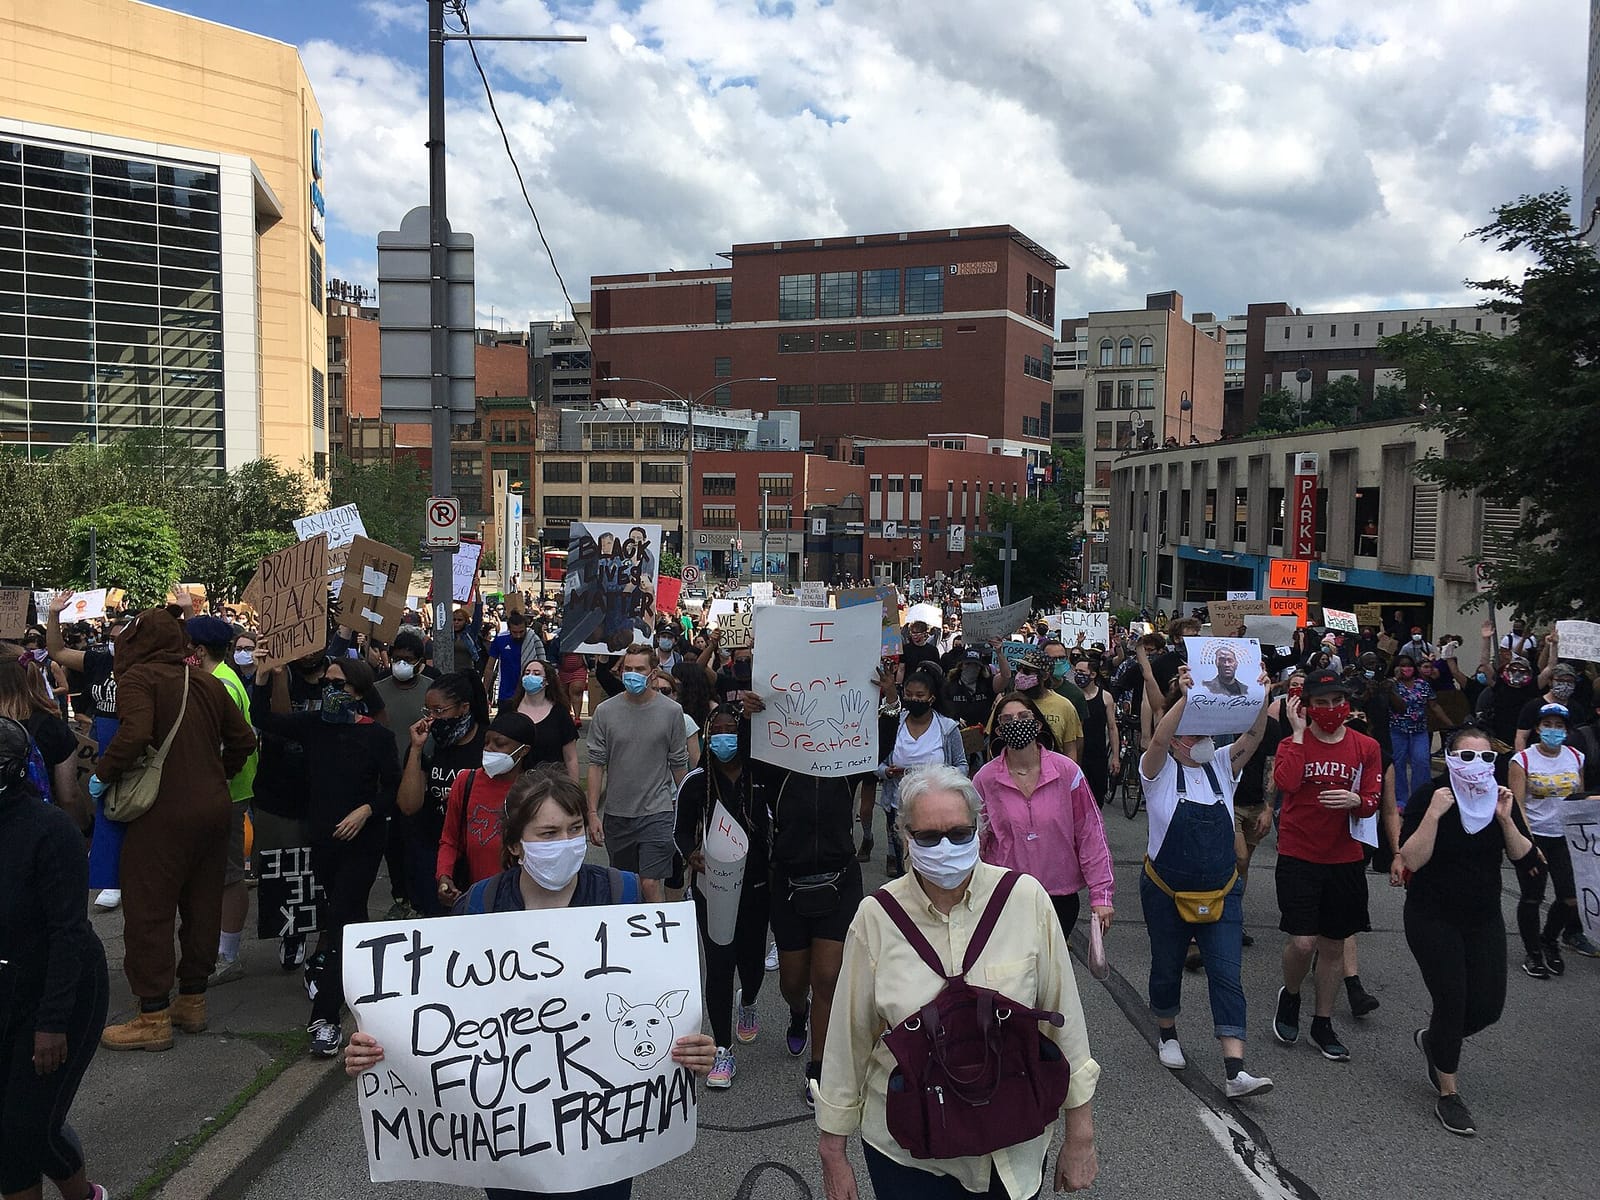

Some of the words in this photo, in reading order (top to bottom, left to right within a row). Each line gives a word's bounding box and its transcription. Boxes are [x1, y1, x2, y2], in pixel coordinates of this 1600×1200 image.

[1300, 480, 1313, 538] PARK
[579, 535, 651, 562] BLACK
[262, 536, 325, 593] PROTECT
[583, 563, 642, 585] LIVES
[1282, 563, 1297, 572] 7TH
[1281, 577, 1296, 586] AVE
[261, 580, 325, 636] BLACK
[570, 589, 654, 617] MATTER
[1274, 601, 1303, 610] DETOUR
[717, 614, 735, 627] WE
[1062, 613, 1101, 627] BLACK
[719, 628, 752, 646] BREA
[809, 622, 834, 643] I
[771, 673, 848, 694] Can't
[768, 720, 870, 753] Breathe!
[431, 767, 457, 781] BLA
[811, 761, 832, 771] Am
[834, 761, 843, 770] I
[848, 756, 872, 768] next?
[1304, 761, 1360, 781] EMPLE
[279, 905, 317, 937] CK
[354, 929, 434, 1005] It
[446, 941, 565, 988] was
[584, 910, 681, 980] 1st
[412, 997, 592, 1065] Degree.
[431, 1032, 618, 1110] FUCK
[362, 1069, 418, 1098] D.A.
[371, 1102, 551, 1161] MICHAEL
[551, 1068, 696, 1155] FREEMAN
